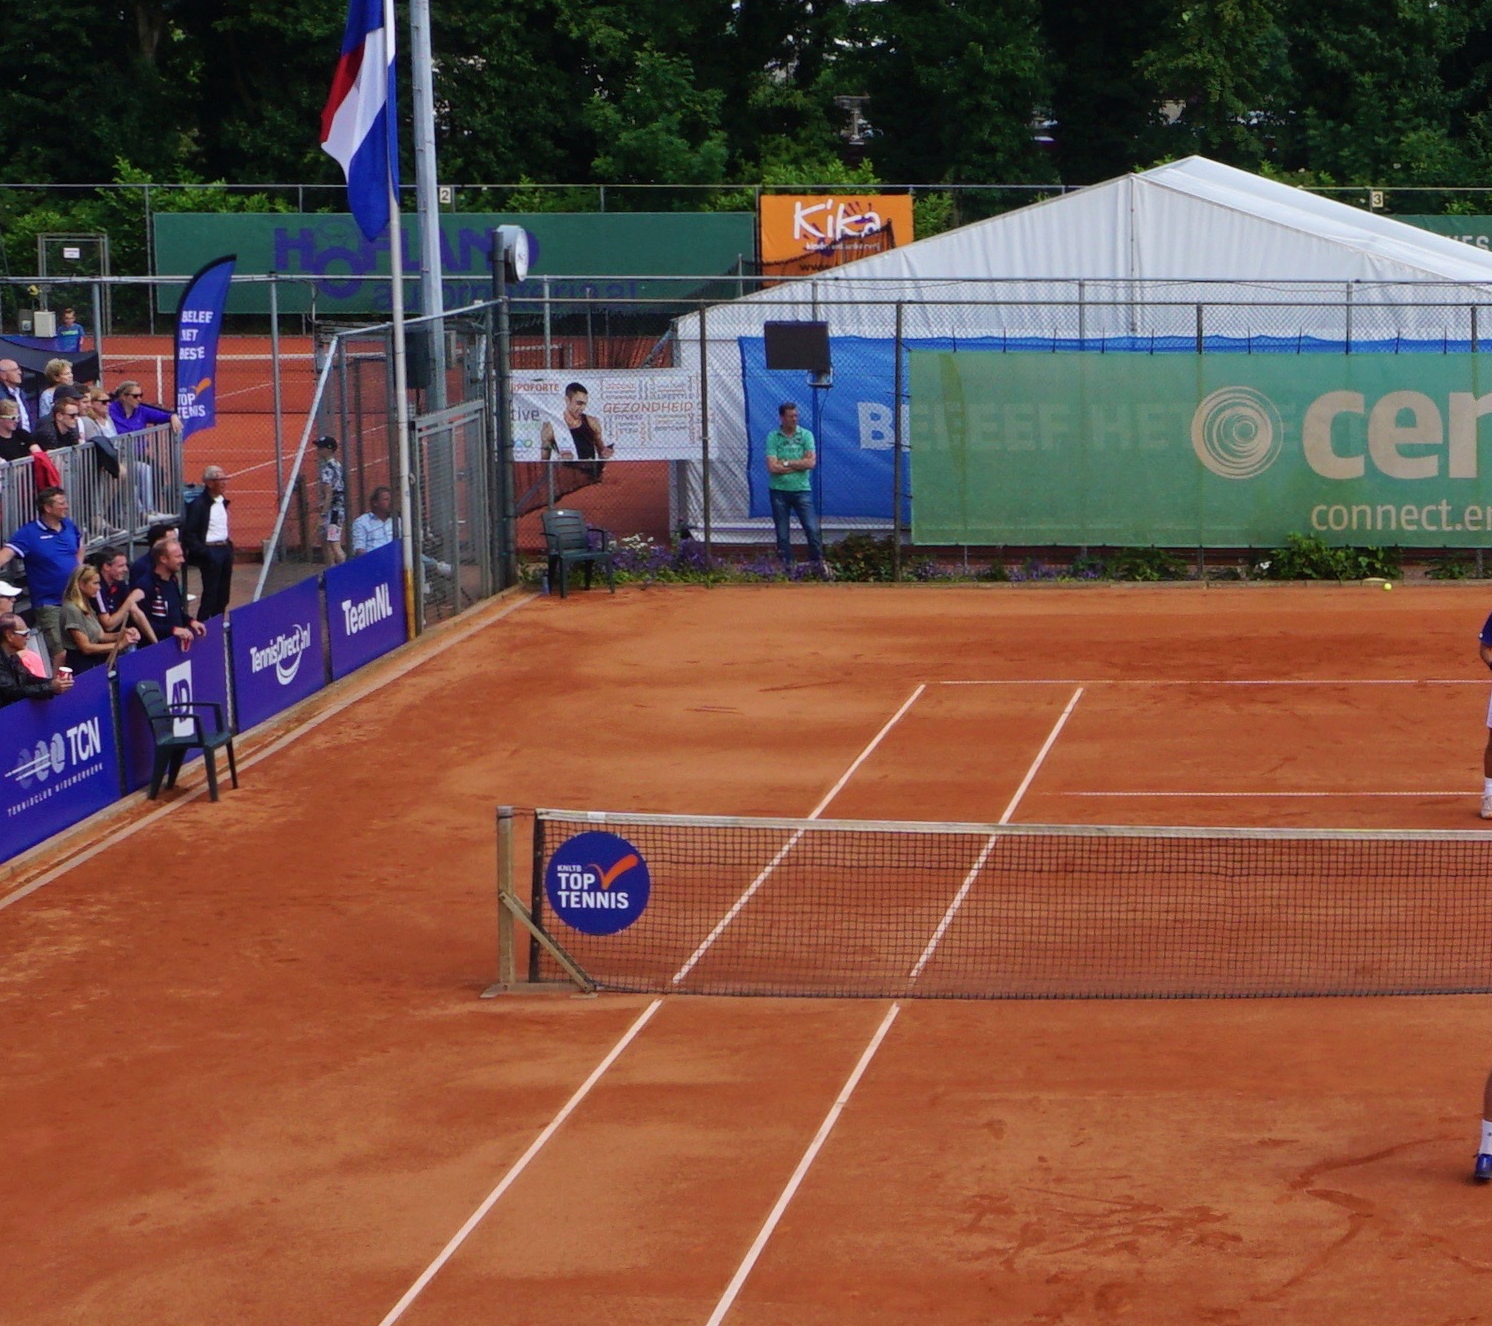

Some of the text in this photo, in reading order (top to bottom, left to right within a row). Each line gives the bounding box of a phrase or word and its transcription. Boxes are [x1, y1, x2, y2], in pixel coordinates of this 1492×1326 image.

[441, 189, 450, 201] 2
[1373, 193, 1383, 206] 3
[603, 401, 694, 414] GEZONDHEID
[342, 582, 392, 636] TeamNL
[66, 716, 102, 766] TCN
[557, 873, 596, 890] TOP
[557, 891, 630, 909] TENNIS
